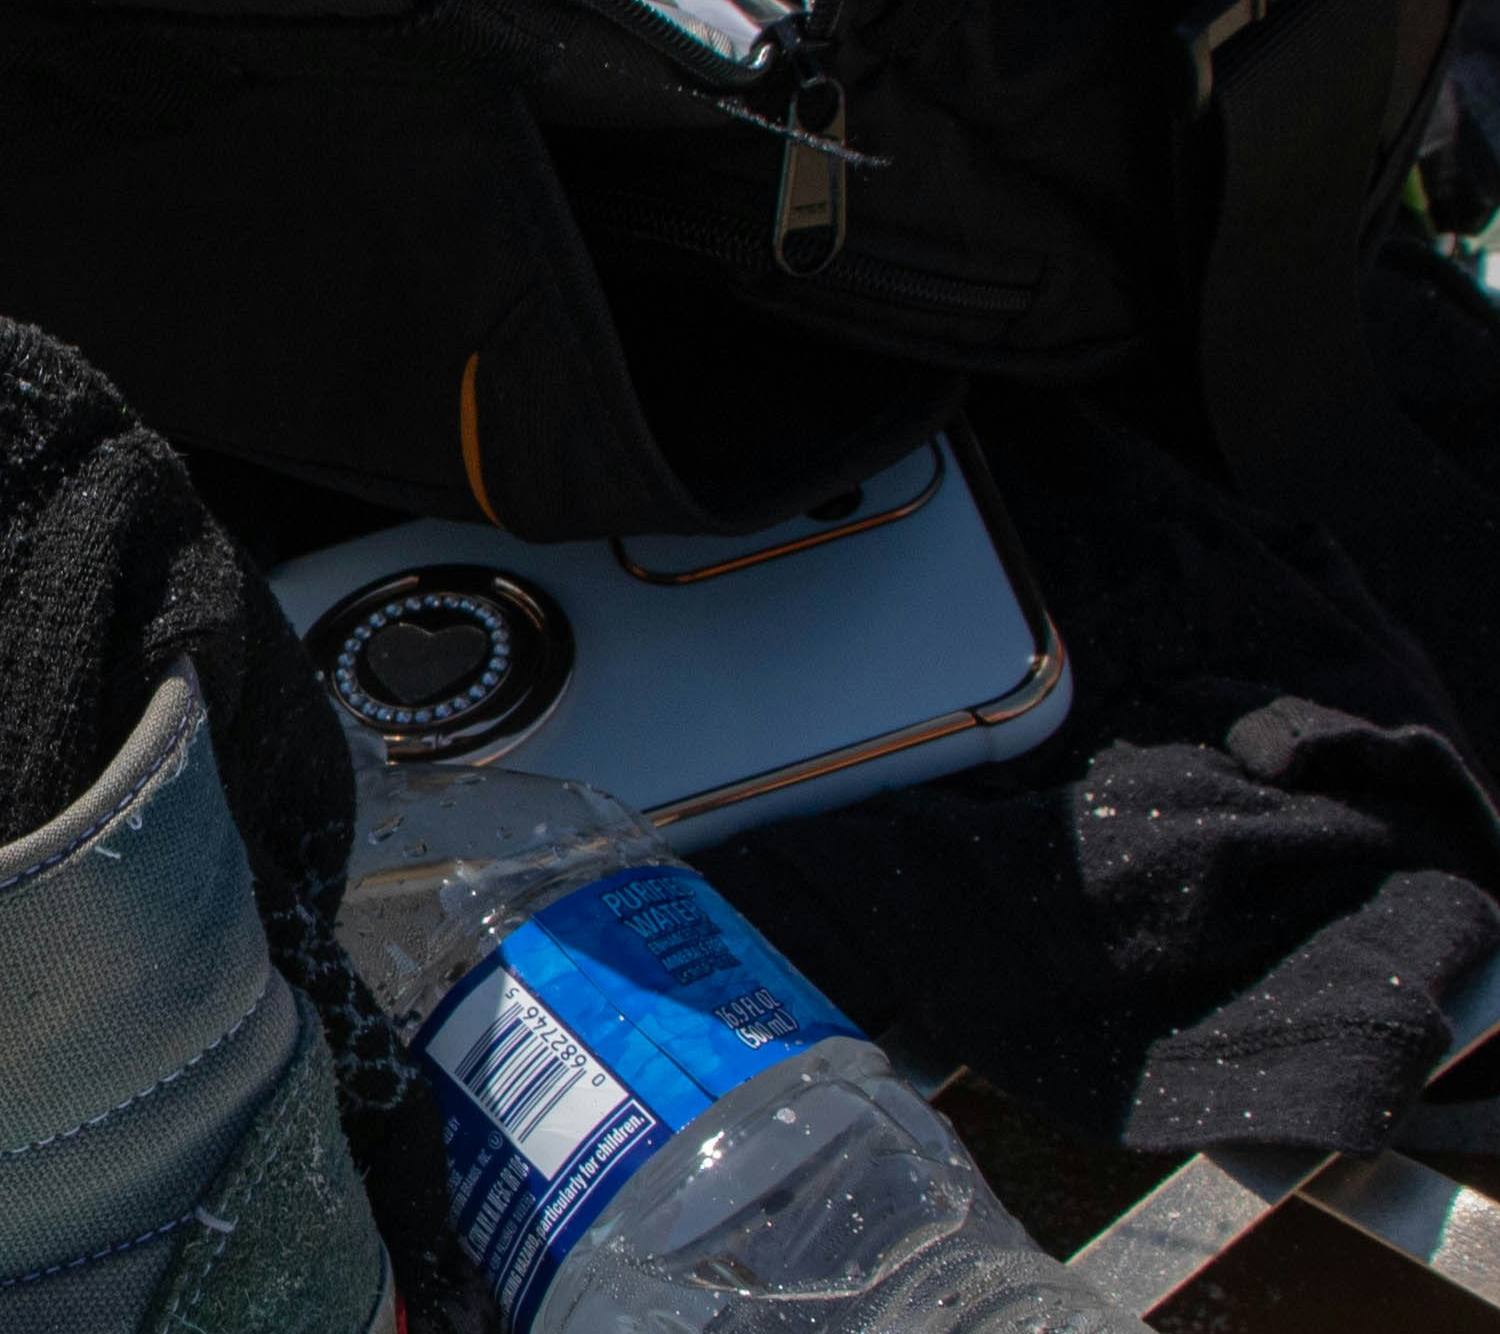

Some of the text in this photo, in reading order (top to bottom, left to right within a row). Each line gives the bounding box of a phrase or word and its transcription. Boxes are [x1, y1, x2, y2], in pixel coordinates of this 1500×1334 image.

[622, 897, 706, 939] WATER
[713, 988, 781, 1029] 16.9 FL OZ
[735, 1007, 798, 1050] (500 mL)
[504, 986, 606, 1087] 0 682746 5
[535, 1171, 589, 1241] particularly
[576, 1154, 602, 1182] for
[594, 1112, 647, 1165] children.
